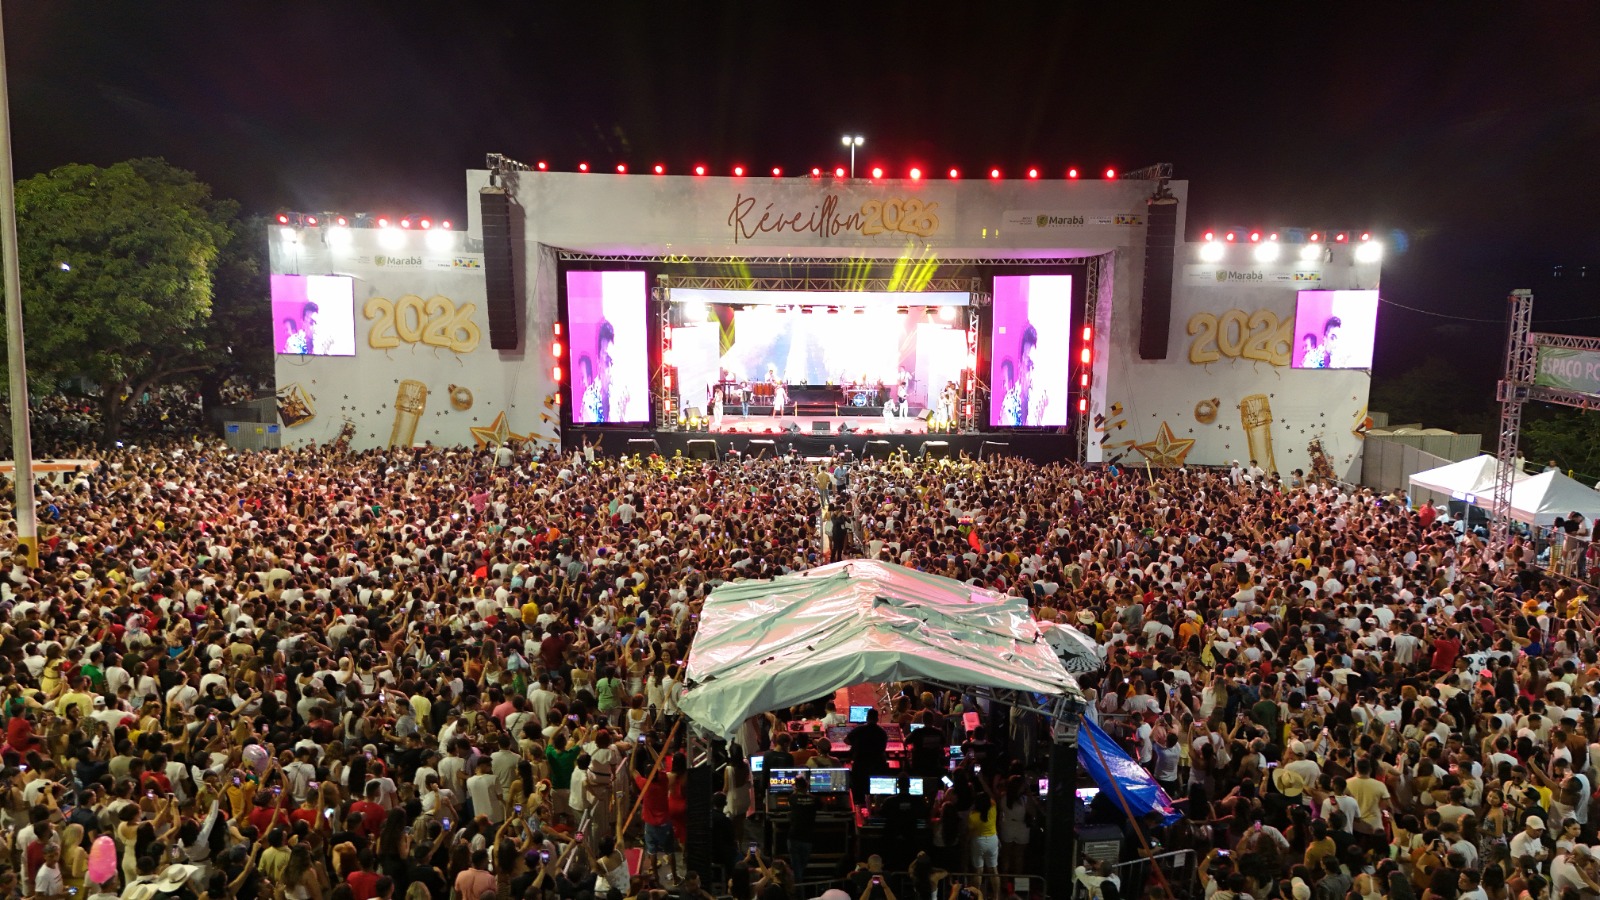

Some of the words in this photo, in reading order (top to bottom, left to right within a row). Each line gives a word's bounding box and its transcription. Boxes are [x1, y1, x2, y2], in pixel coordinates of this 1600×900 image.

[728, 193, 864, 244] Réveillon
[861, 198, 940, 237] 2026
[1048, 215, 1084, 225] Marabá
[387, 256, 422, 265] Marabá
[1228, 270, 1263, 280] Marabá
[363, 294, 481, 353] 2026
[1187, 309, 1294, 366] 2026
[1541, 356, 1582, 382] ESPAÇO
